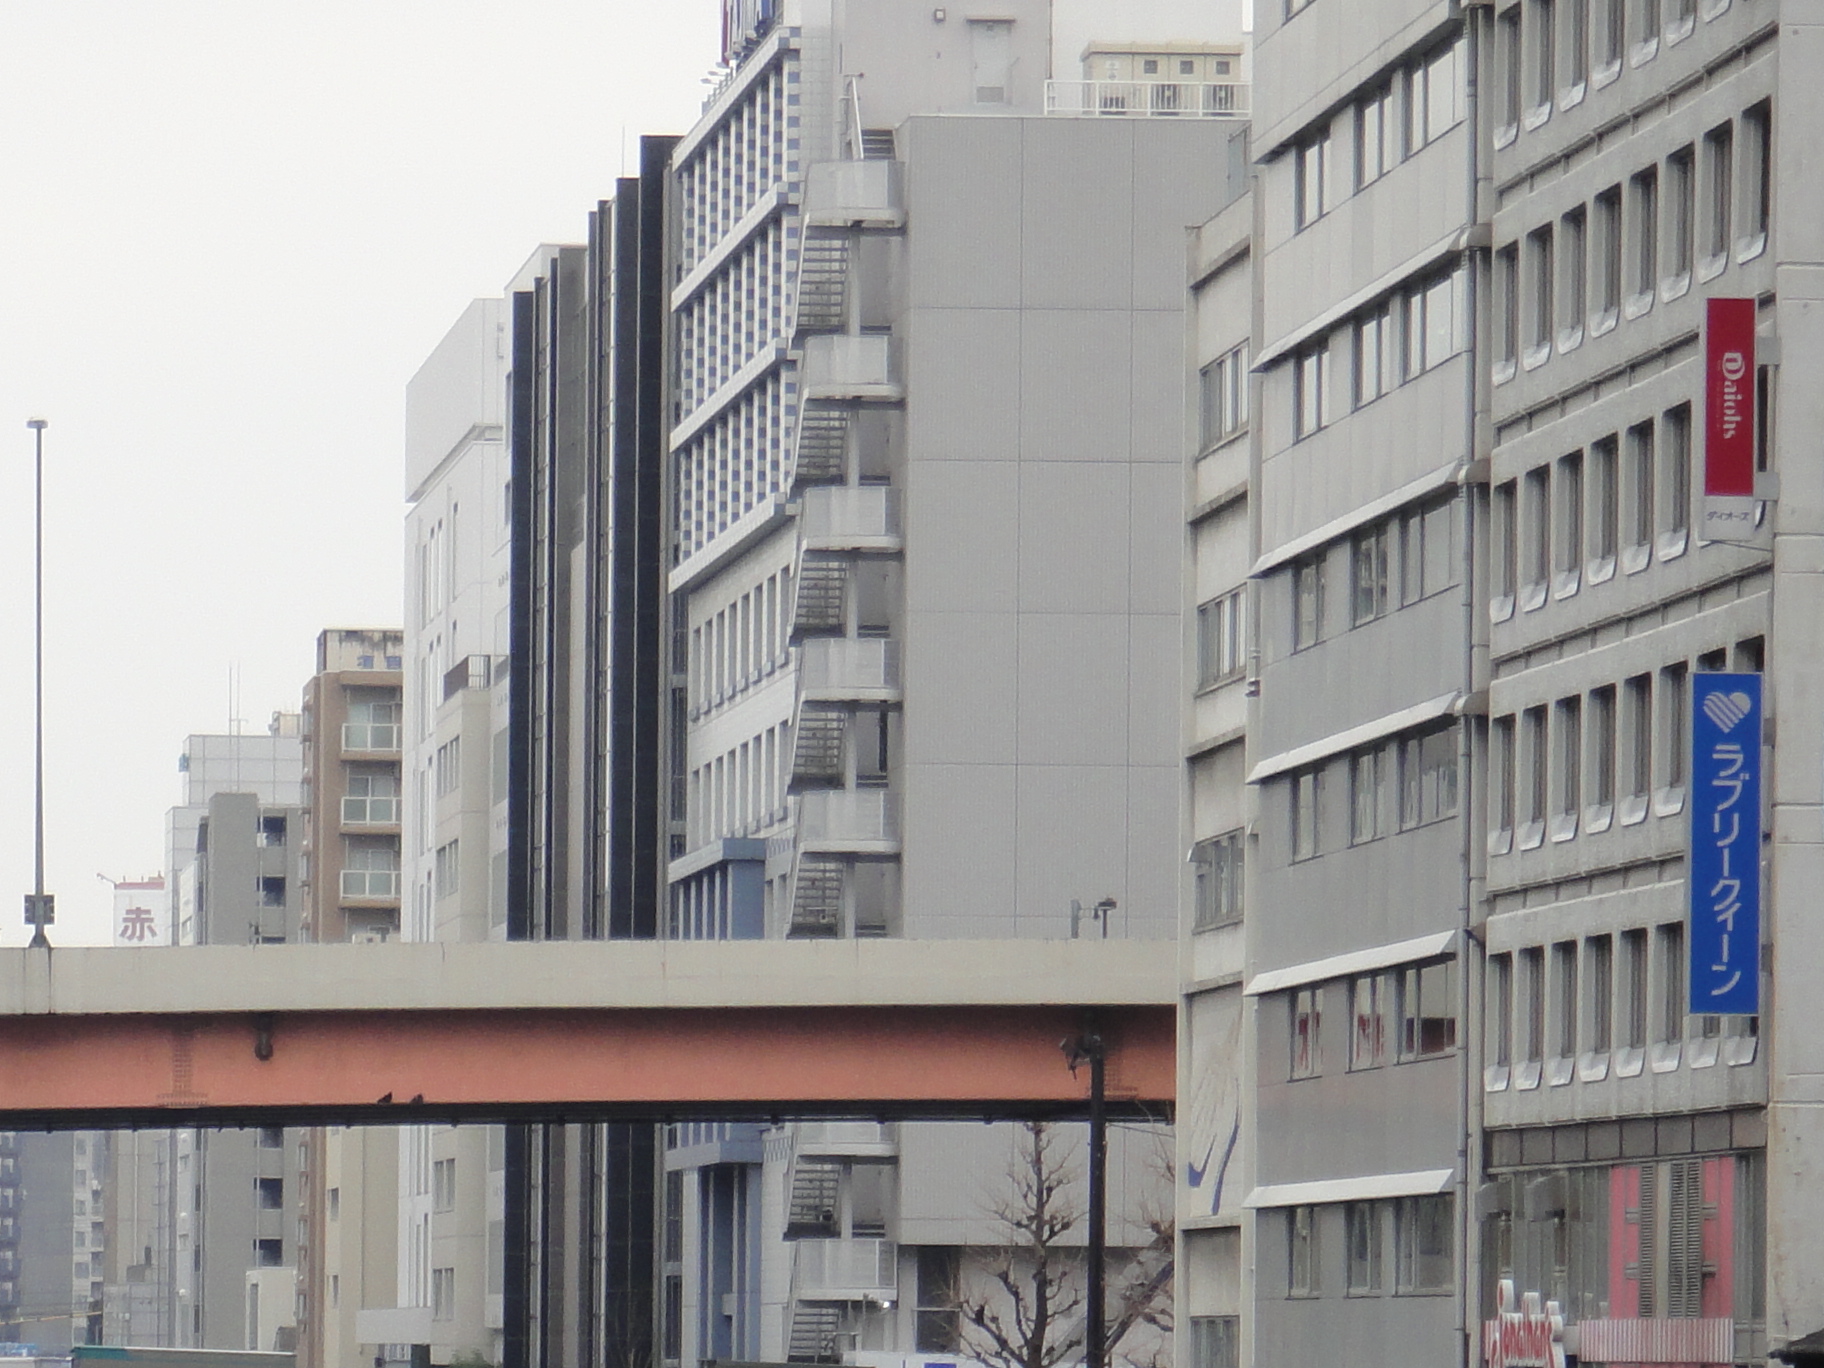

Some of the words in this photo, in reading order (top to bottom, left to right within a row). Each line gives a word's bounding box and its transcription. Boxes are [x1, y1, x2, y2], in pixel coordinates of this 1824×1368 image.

[1722, 351, 1746, 439] Daiohs
[1706, 510, 1751, 522] ダイオーズ
[119, 906, 157, 941] 赤
